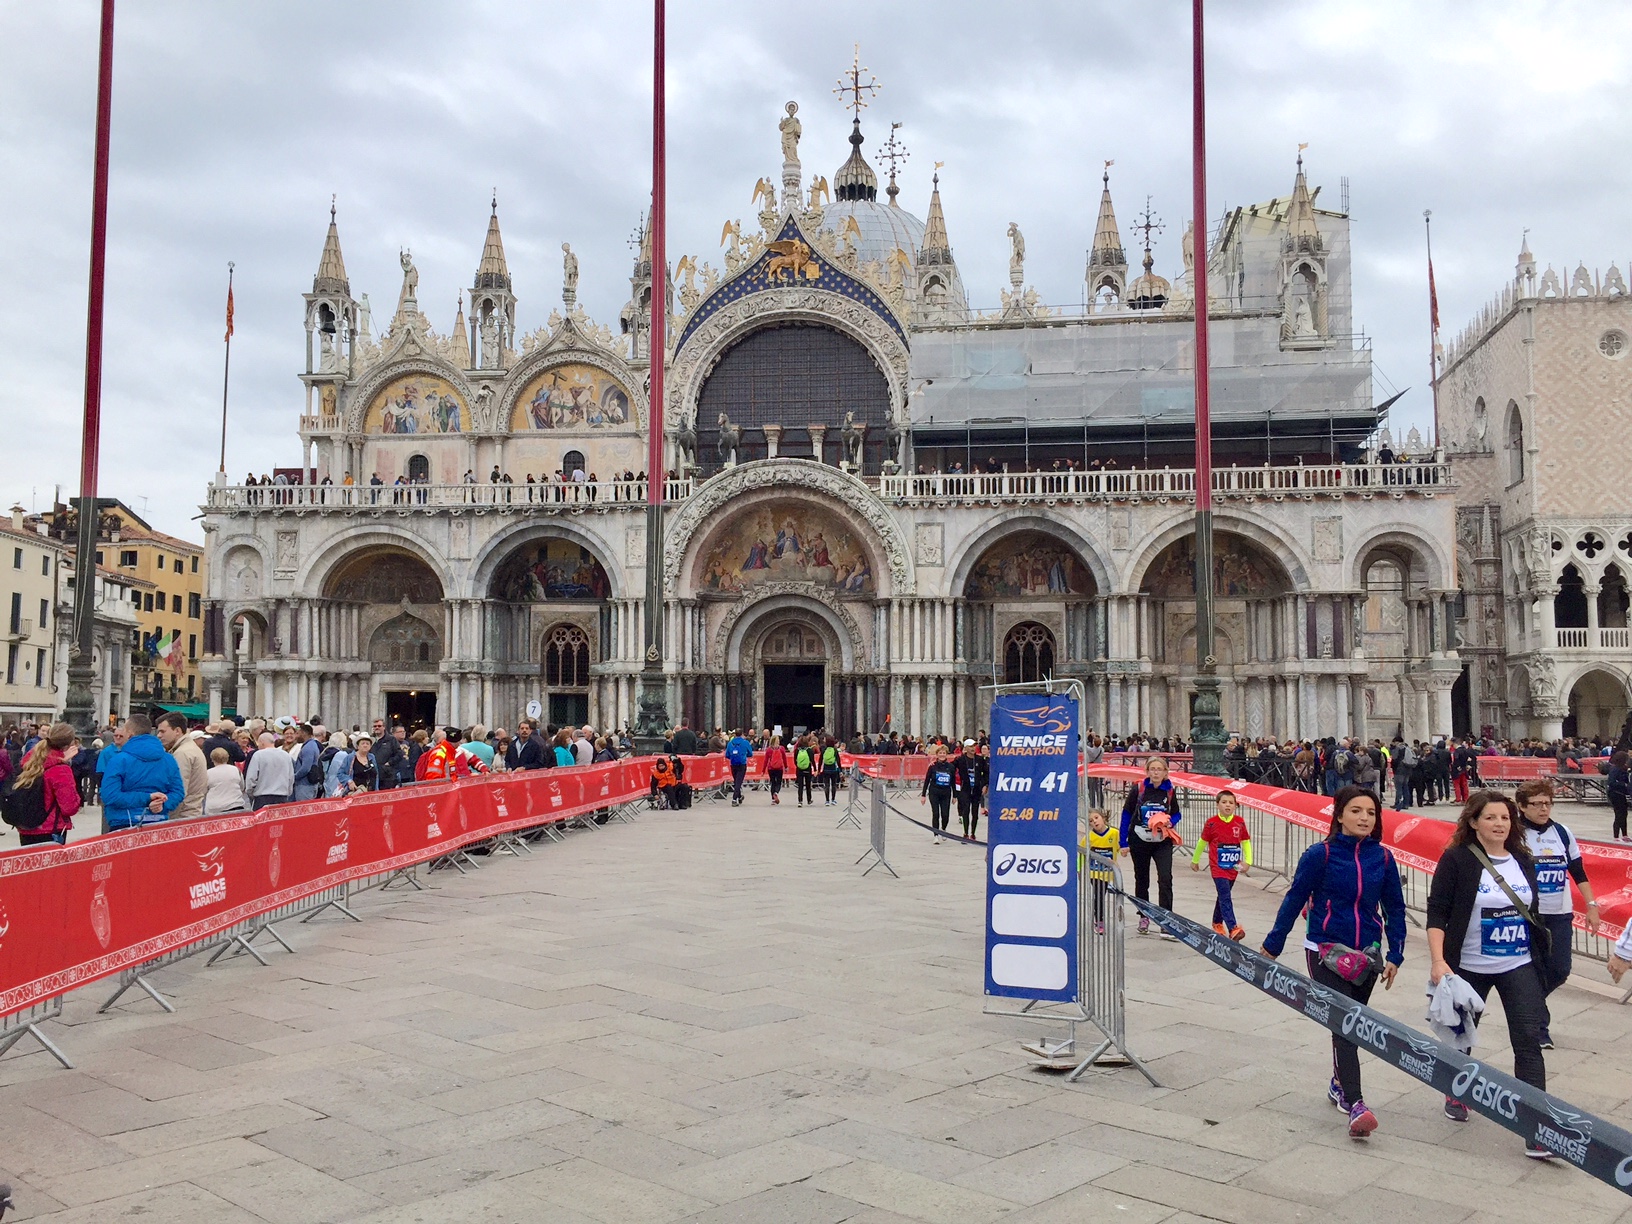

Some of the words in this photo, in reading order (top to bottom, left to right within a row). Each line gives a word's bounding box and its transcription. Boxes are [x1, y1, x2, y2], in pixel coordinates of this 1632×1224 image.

[531, 705, 537, 714] 7
[1000, 734, 1068, 748] VENICE
[996, 746, 1066, 756] MARATHON
[995, 772, 1033, 792] km
[1039, 771, 1069, 793] 41
[999, 807, 1035, 821] 25.48
[1038, 808, 1060, 821] mi
[1220, 852, 1240, 862] 2760
[1016, 858, 1062, 875] asics
[1536, 870, 1565, 883] 4770
[189, 877, 227, 899] VENICE
[190, 890, 227, 910] MARATHON
[1492, 910, 1519, 918] GARMIN
[1489, 924, 1527, 943] 4474
[1303, 1007, 1329, 1025] MARATHON
[1305, 999, 1330, 1019] VENICE
[1398, 1059, 1433, 1083] MARATHON
[1400, 1051, 1434, 1076] VENICE
[1534, 1132, 1585, 1166] MARATHON
[1537, 1122, 1588, 1158] VENICE
